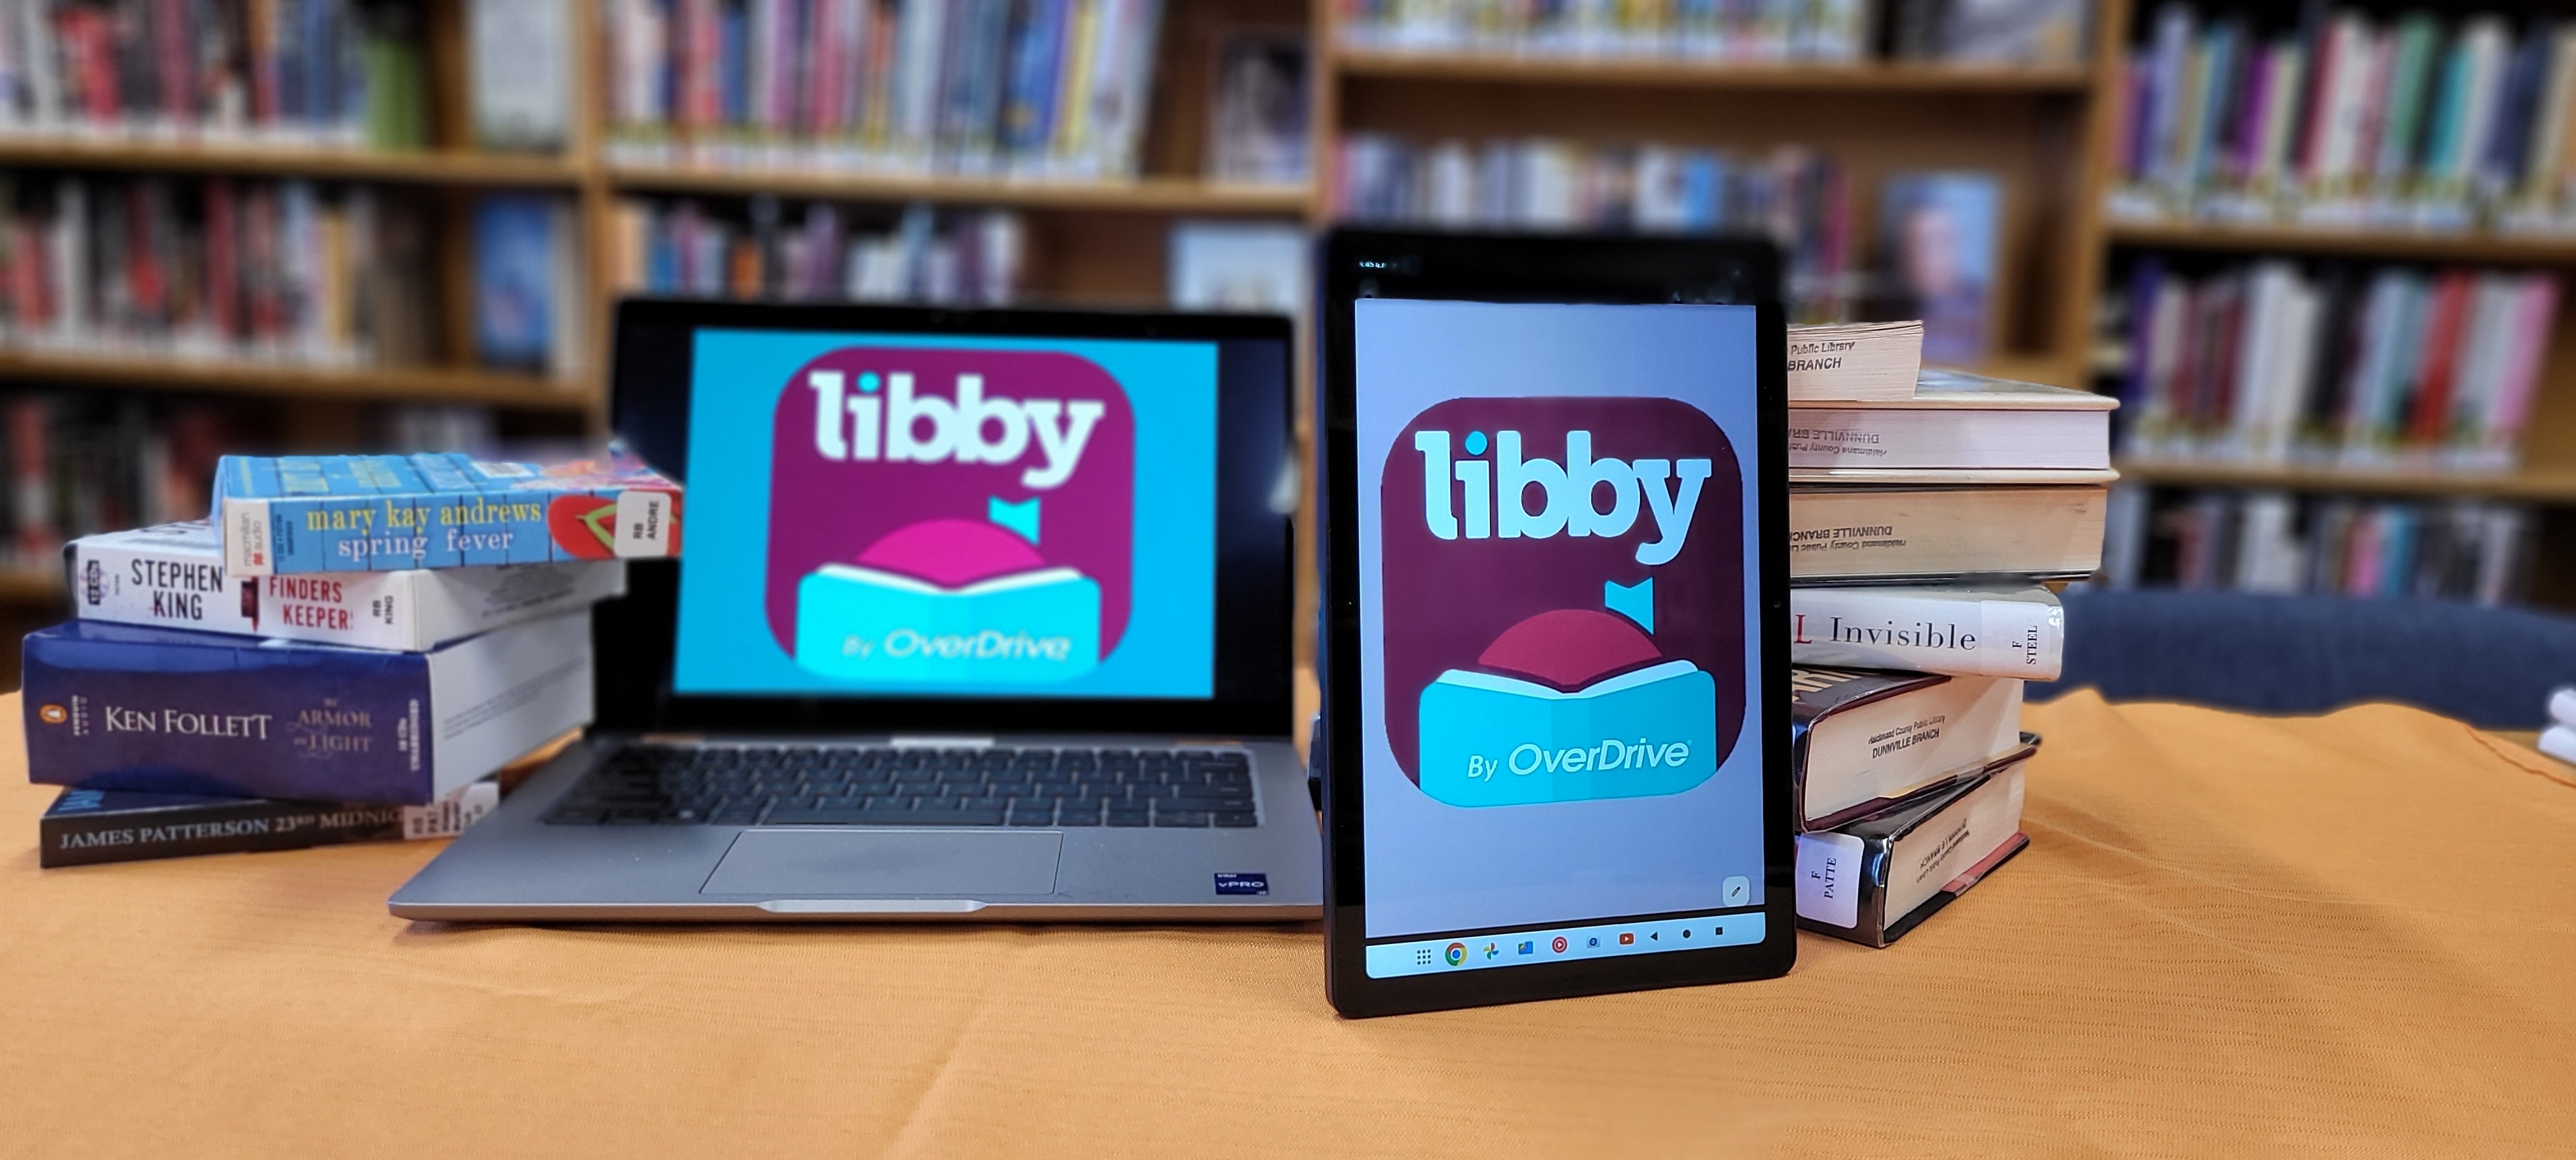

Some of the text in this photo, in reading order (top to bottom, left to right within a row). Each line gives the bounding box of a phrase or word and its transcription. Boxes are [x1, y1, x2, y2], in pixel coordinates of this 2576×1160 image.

[1791, 341, 1855, 355] Public Library
[1788, 357, 1842, 371] BRANCH
[809, 370, 1105, 489] libby
[1813, 430, 1880, 445] DUNNVILLE
[1809, 443, 1840, 454] County
[1414, 430, 1712, 565] libby
[307, 497, 542, 537] mary kay andrews
[633, 523, 643, 540] RB
[647, 500, 659, 540] ANDRE
[1832, 526, 1893, 538] DUNNVILLE
[339, 528, 514, 562] spring fever
[131, 558, 223, 593] STEPHEN
[269, 576, 342, 604] FINDERS
[153, 590, 203, 620] KING
[372, 600, 381, 617] RB
[385, 595, 394, 625] KING
[841, 628, 1071, 660] By OverDrive
[1828, 616, 1976, 651] Invisible
[2012, 640, 2023, 649] F
[2026, 625, 2038, 665] STEEL
[105, 705, 273, 741] KEN FOLLETT
[298, 709, 372, 728] ARMOR
[309, 733, 373, 752] LIGHT
[1872, 728, 1940, 759] DUNNVILLE BRANCH
[1467, 737, 1690, 782] By OverDrive
[59, 828, 134, 850] JAMES
[140, 818, 270, 844] PATTERSON
[1811, 871, 1821, 880] F
[1823, 857, 1837, 899] PATTE
